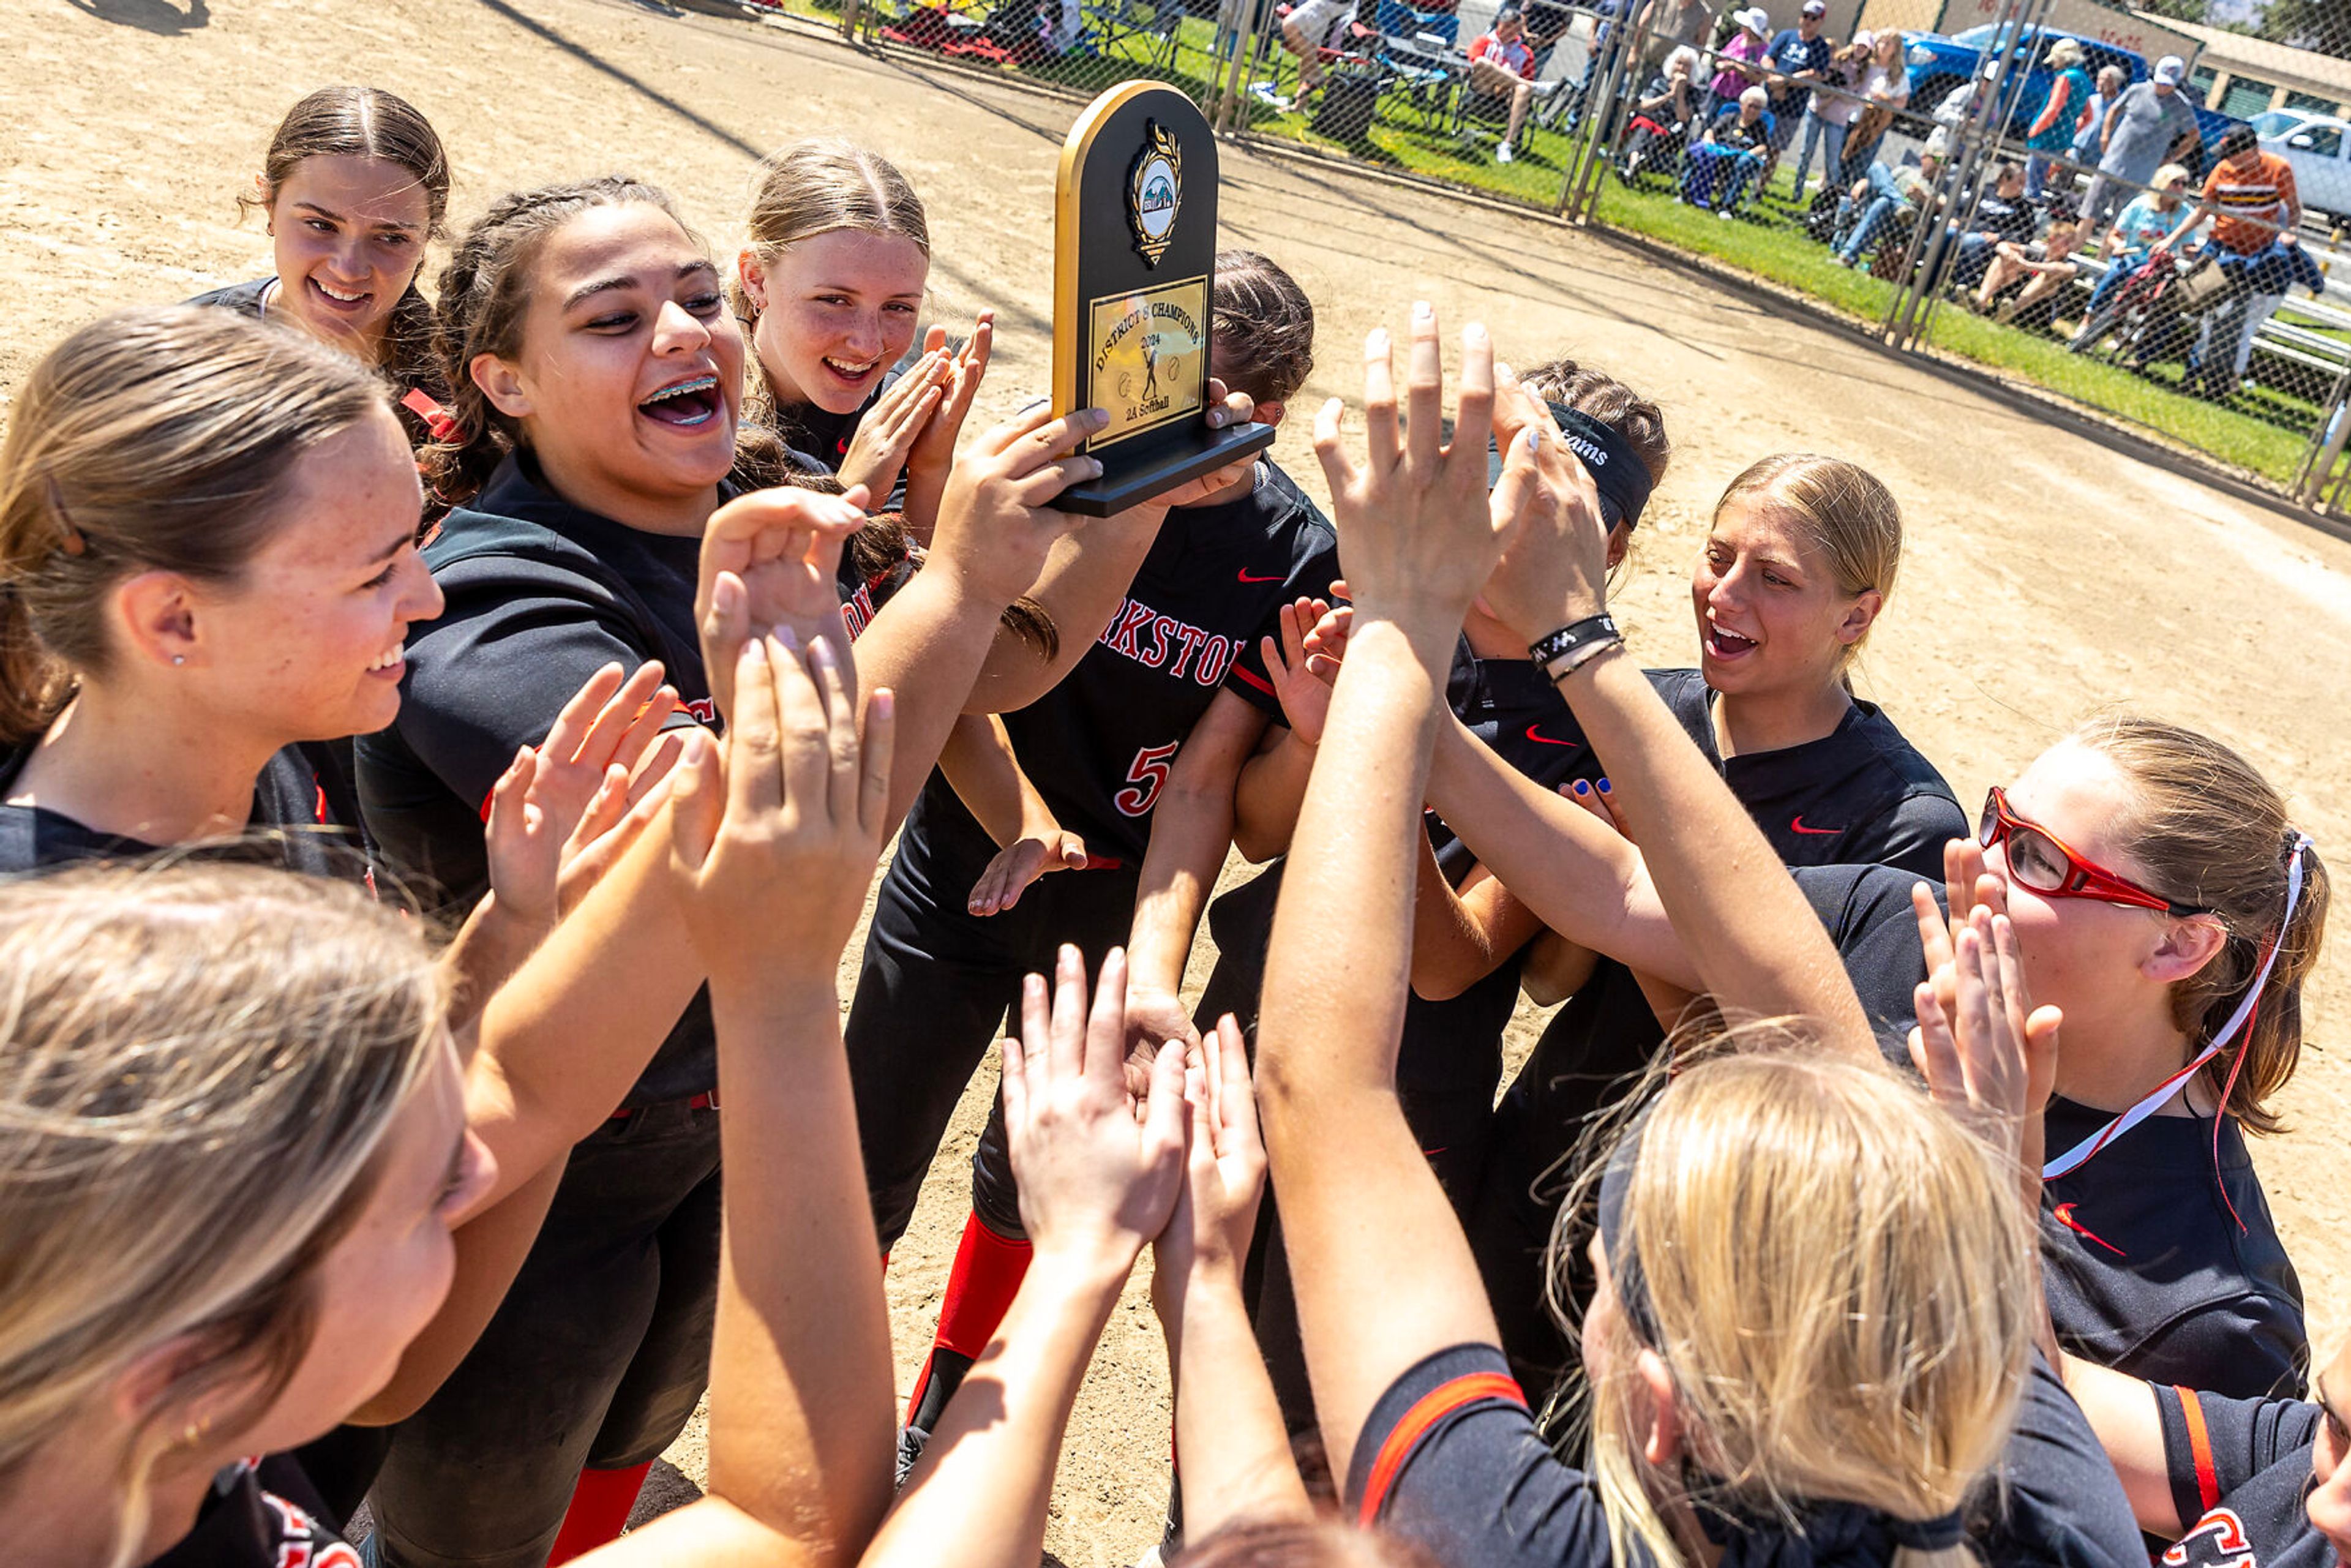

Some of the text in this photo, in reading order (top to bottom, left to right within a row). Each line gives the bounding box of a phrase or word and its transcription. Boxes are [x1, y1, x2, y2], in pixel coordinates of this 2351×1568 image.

[1096, 302, 1199, 373] DISTRICT 8 CHAMPIONS
[1141, 334, 1160, 349] 2024
[1126, 396, 1169, 421] 2A Softball
[1098, 597, 1248, 687] KSTO
[1114, 739, 1179, 817] 5
